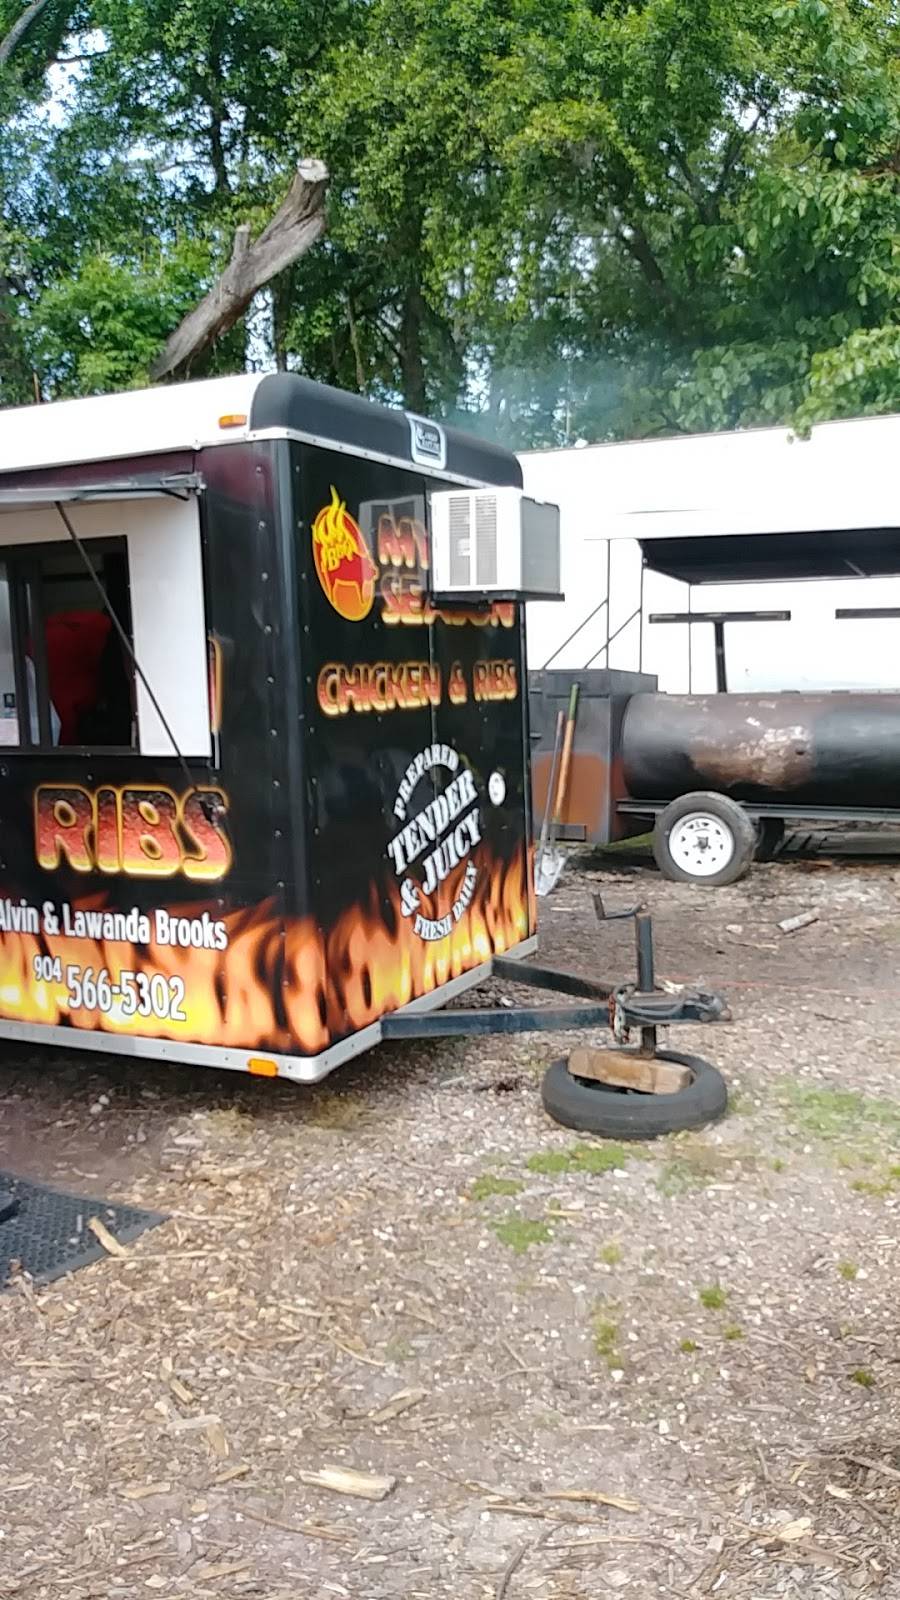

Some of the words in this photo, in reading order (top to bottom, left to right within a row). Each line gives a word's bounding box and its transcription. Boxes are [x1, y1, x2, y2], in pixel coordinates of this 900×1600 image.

[381, 572, 515, 627] SEN
[316, 661, 441, 716] CHICKEN
[448, 661, 468, 704] &
[473, 659, 518, 701] RIBS
[393, 743, 459, 821] PREPARED
[33, 784, 232, 880] RIBS
[388, 769, 478, 875] TENDER
[401, 878, 420, 917] &
[422, 808, 481, 895] JUICY
[413, 914, 452, 941] FRESH
[452, 859, 477, 922] DAILY
[0, 898, 40, 934] Alvin
[42, 900, 60, 936] &
[63, 903, 151, 944] Lawanda
[155, 909, 228, 951] Brooks
[33, 954, 63, 983] 904
[66, 964, 187, 1022] 566-5302
